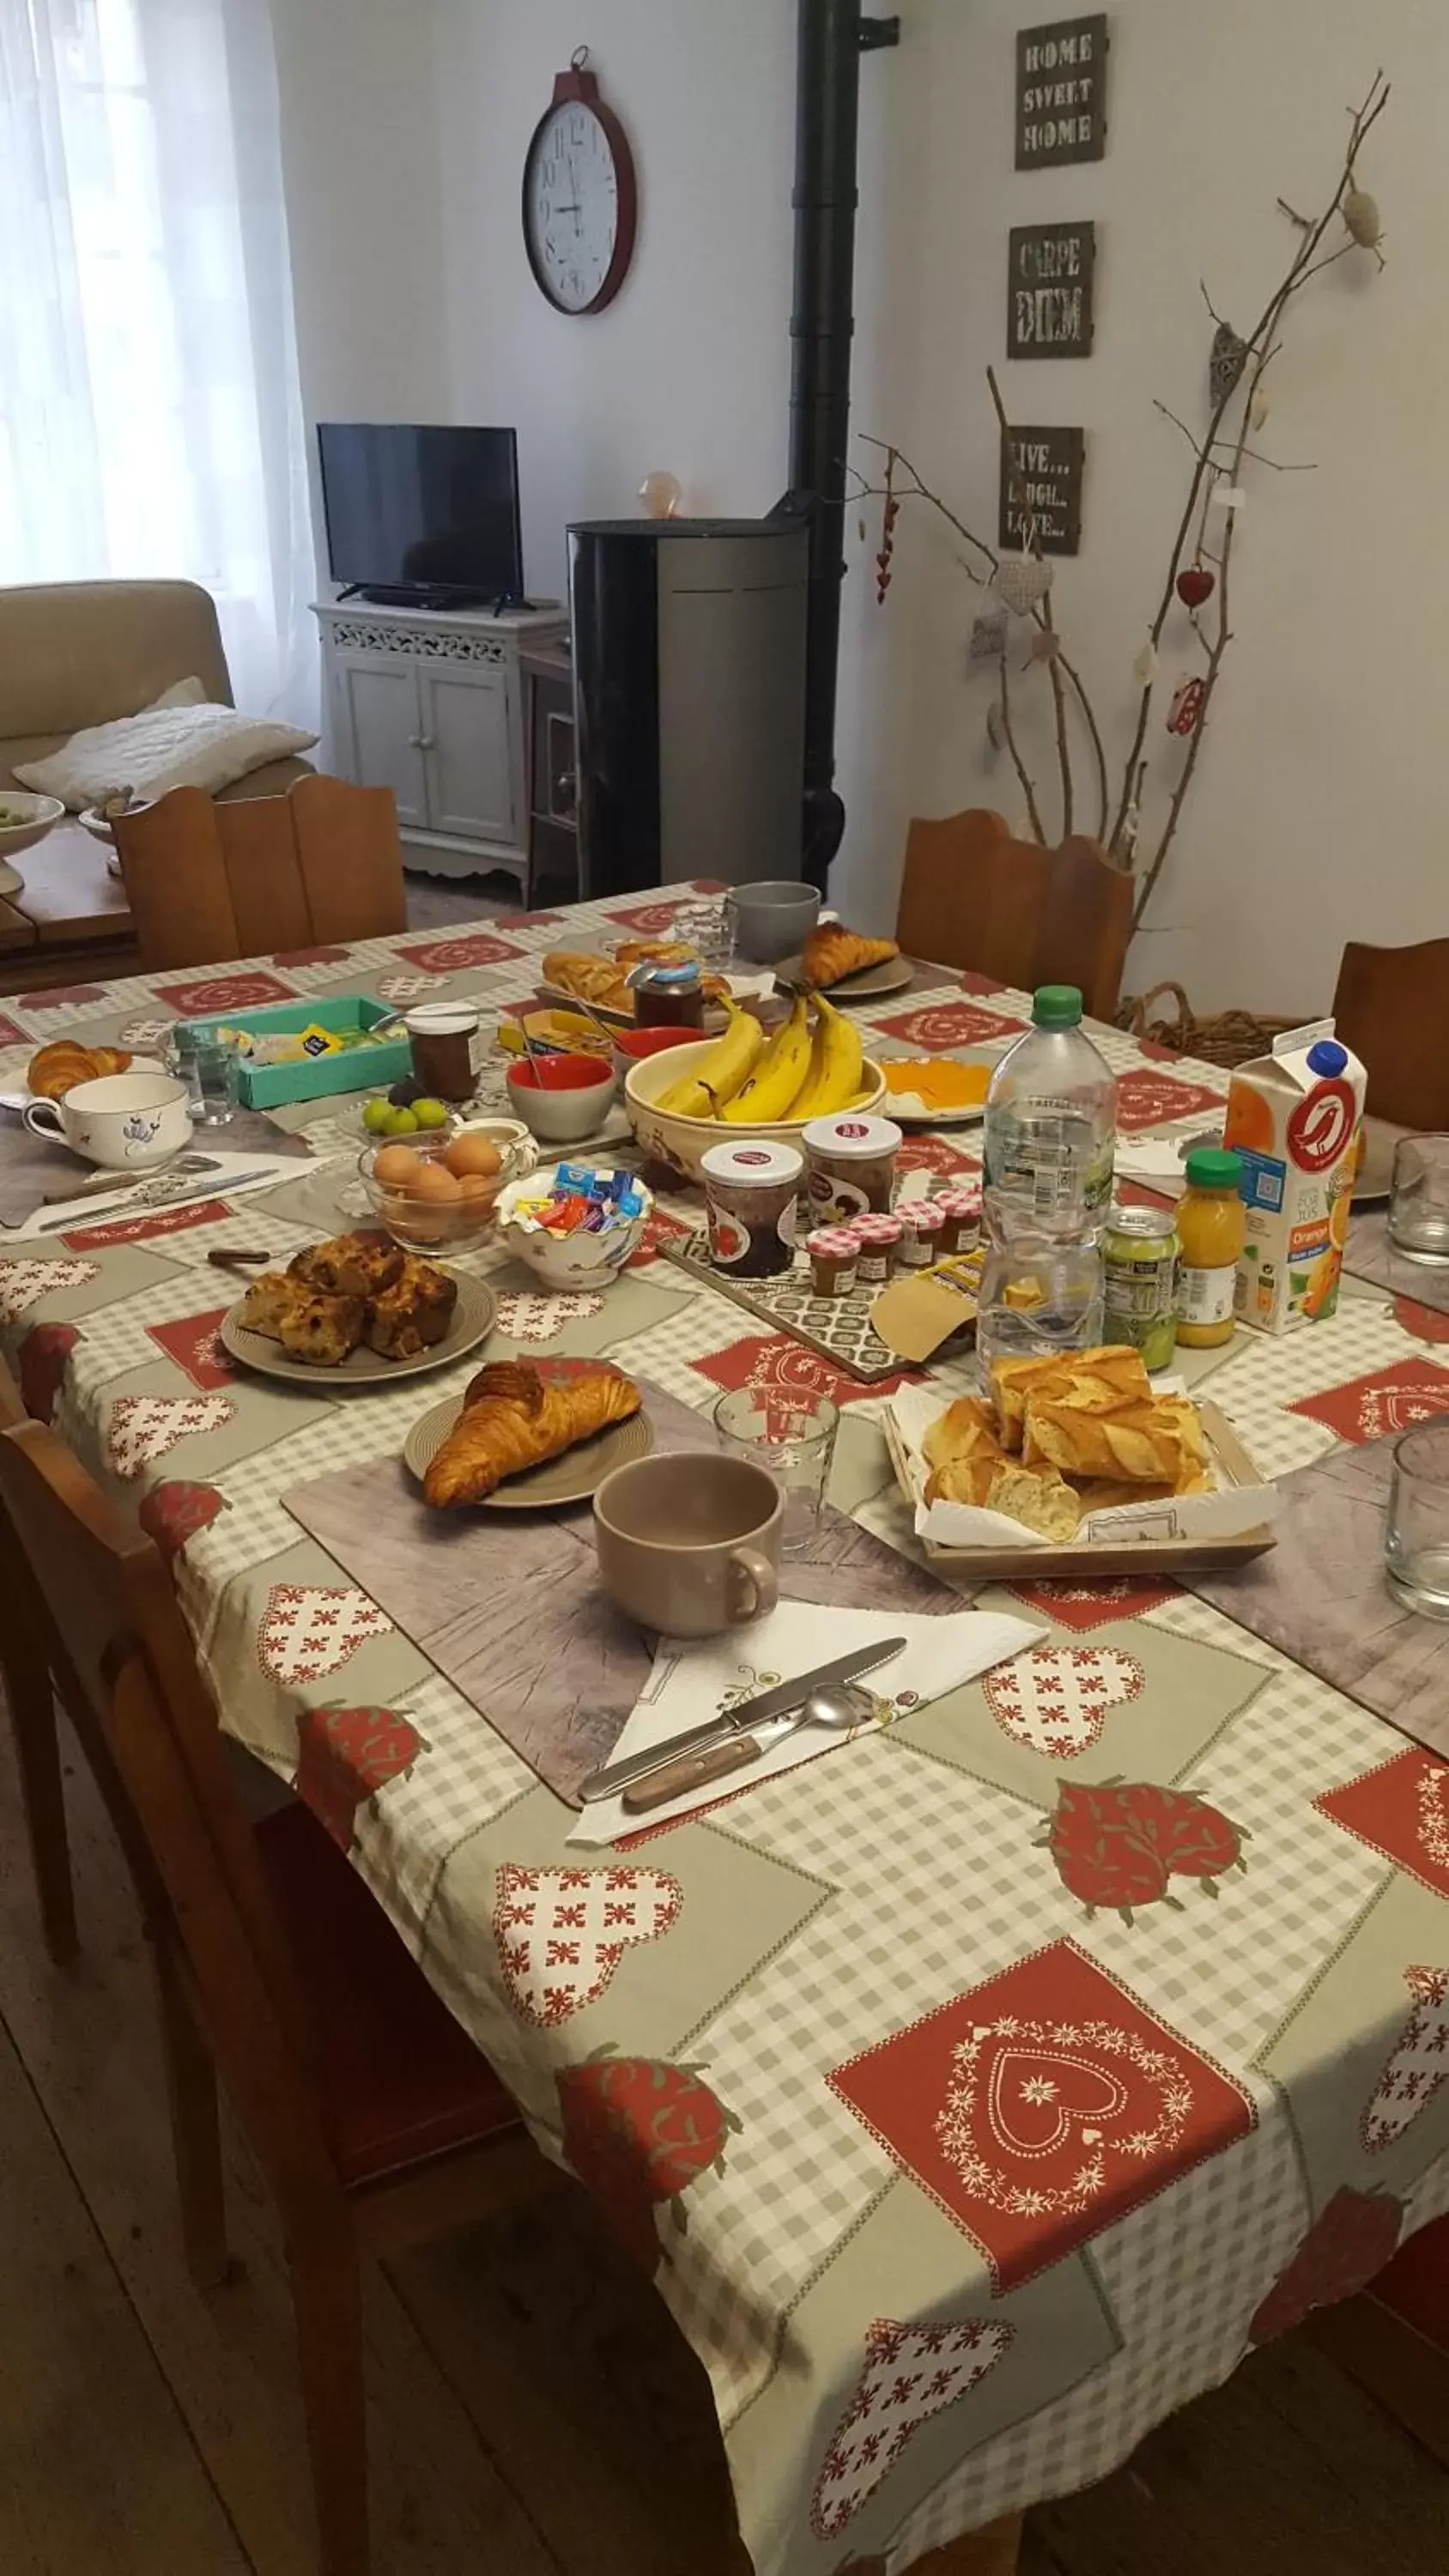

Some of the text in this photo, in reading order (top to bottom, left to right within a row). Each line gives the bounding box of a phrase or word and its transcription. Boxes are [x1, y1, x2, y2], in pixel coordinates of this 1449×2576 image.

[1025, 33, 1093, 72] HOME
[1023, 78, 1093, 112] SWEET
[1023, 115, 1092, 152] HOME
[1019, 237, 1080, 277] CARPE
[1016, 286, 1082, 344] DIEM
[1008, 481, 1068, 507] LUGH...
